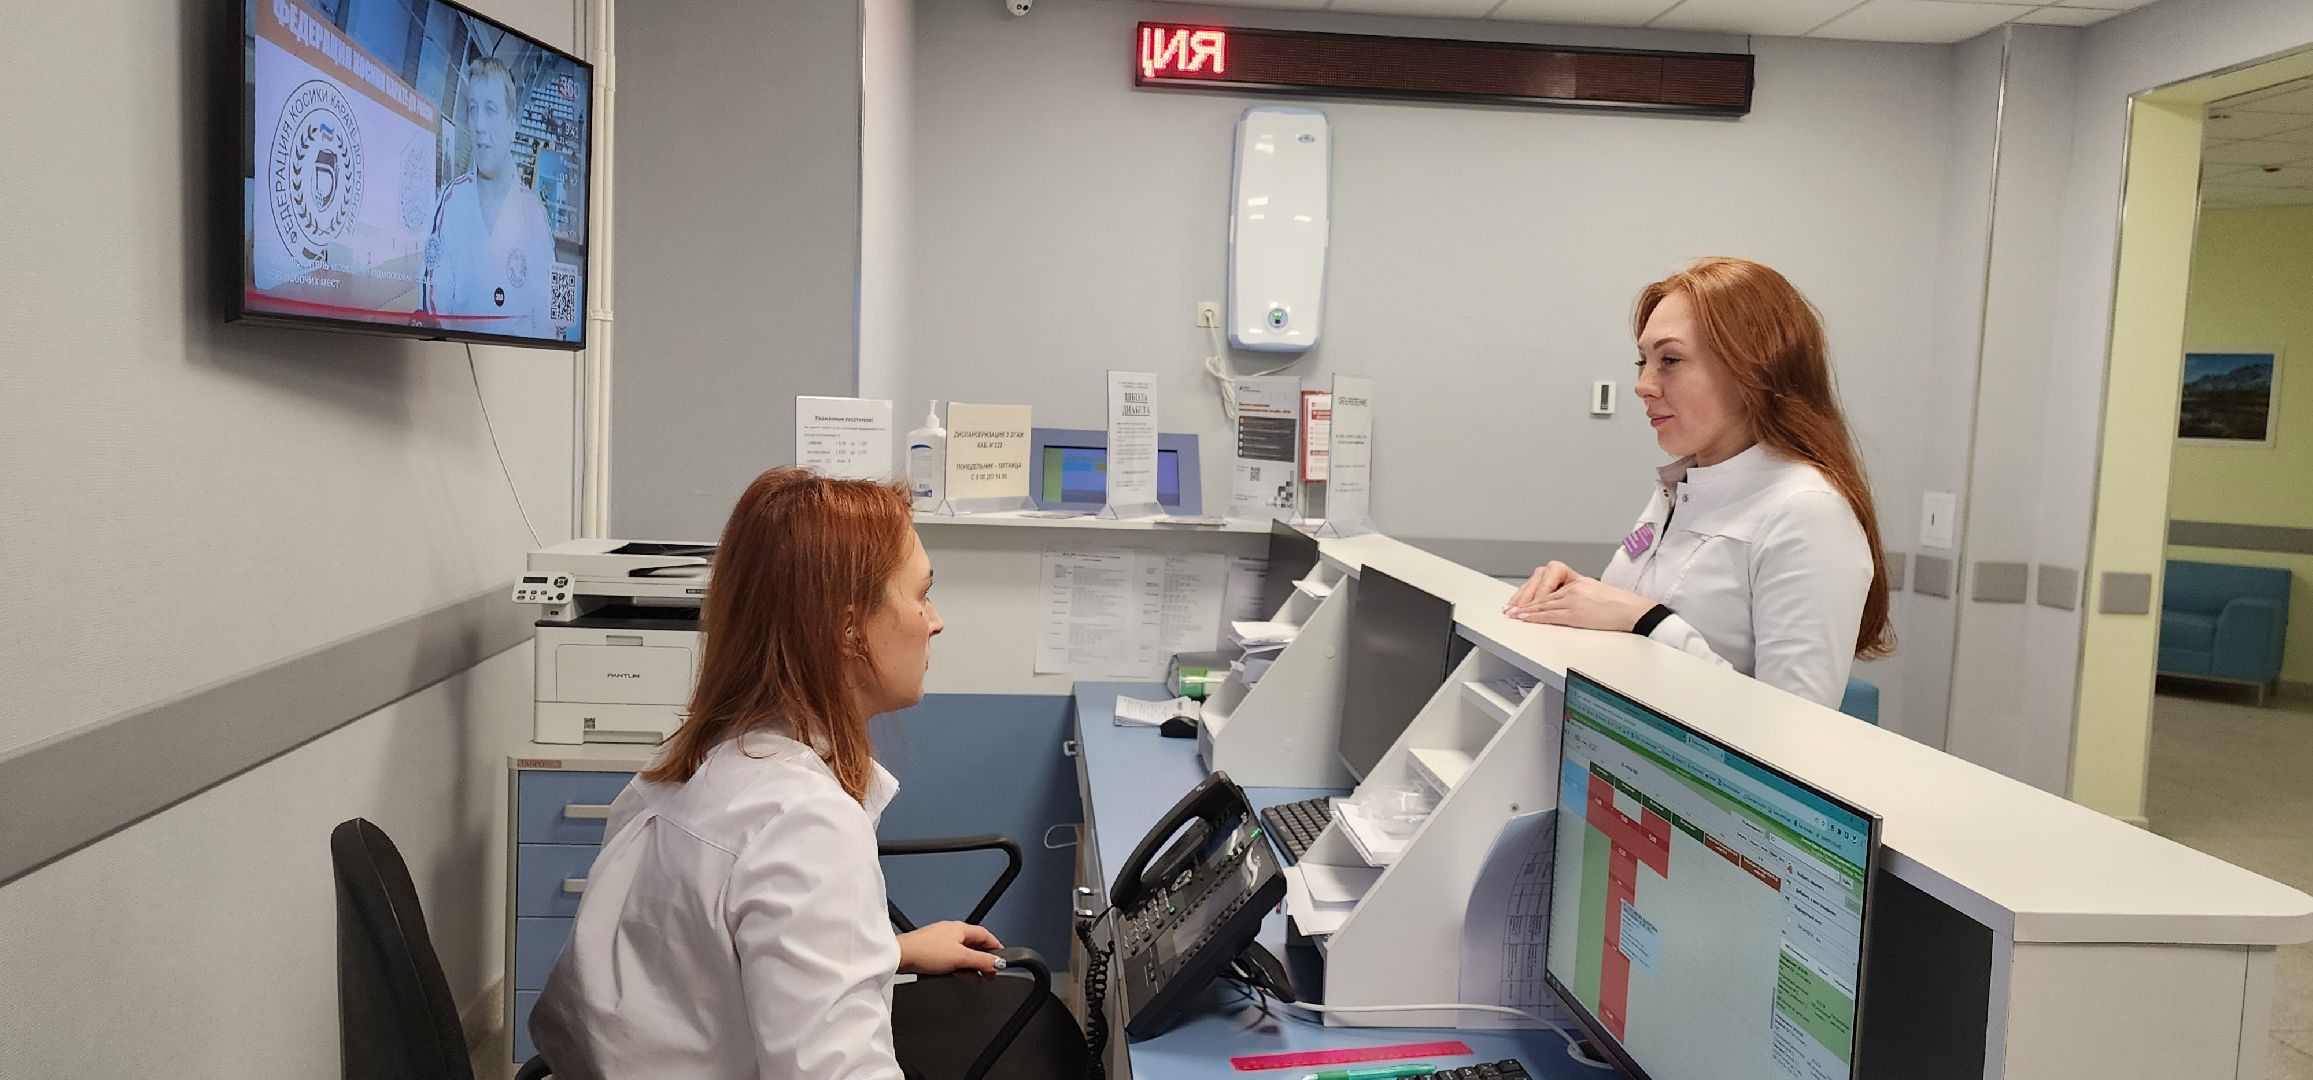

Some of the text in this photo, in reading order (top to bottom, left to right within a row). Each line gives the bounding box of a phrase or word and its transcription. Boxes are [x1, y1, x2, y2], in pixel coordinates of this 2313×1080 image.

[275, 120, 298, 244] ФЕДЕРАЦИЯ
[288, 88, 329, 124] КОСИКИ
[953, 431, 1004, 439] ДИСПАНСЕРИЗАЦИЯ
